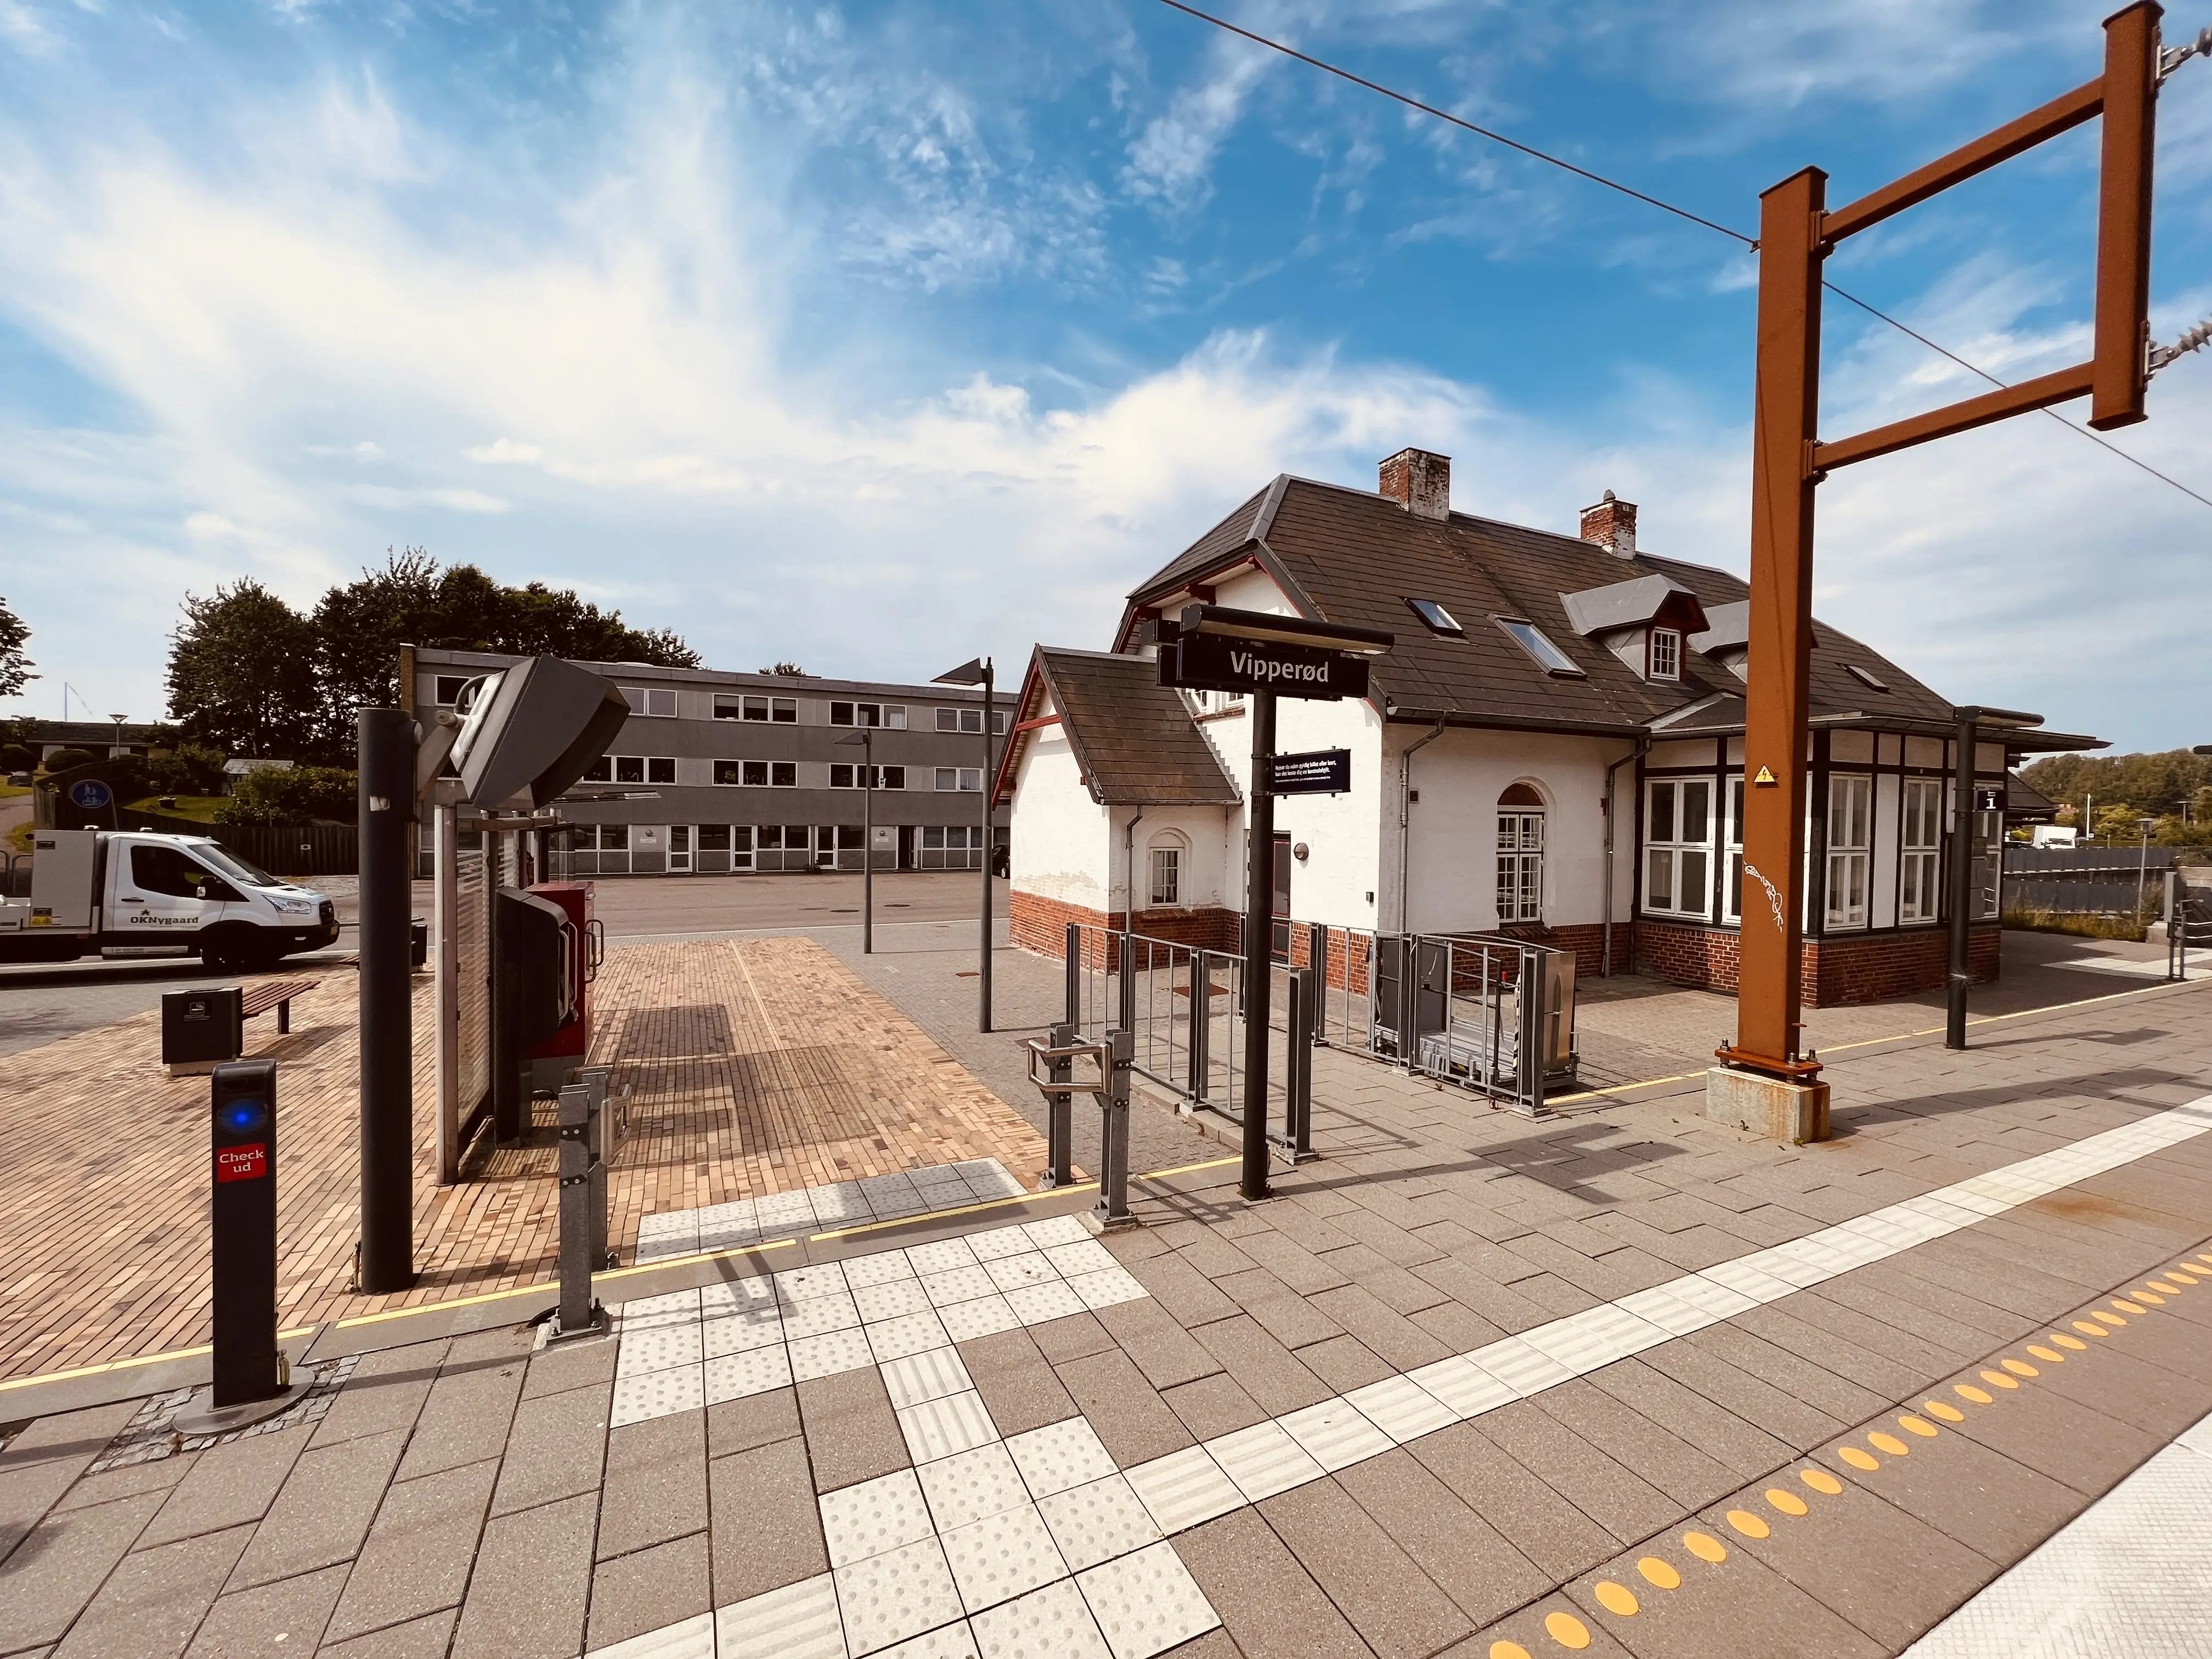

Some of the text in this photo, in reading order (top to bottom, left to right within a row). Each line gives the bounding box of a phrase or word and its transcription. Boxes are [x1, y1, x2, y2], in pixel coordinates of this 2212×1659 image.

[1231, 651, 1328, 682] Vipperød
[1986, 798, 1996, 809] 1
[219, 1149, 264, 1163] Check
[233, 1161, 251, 1172] ud
